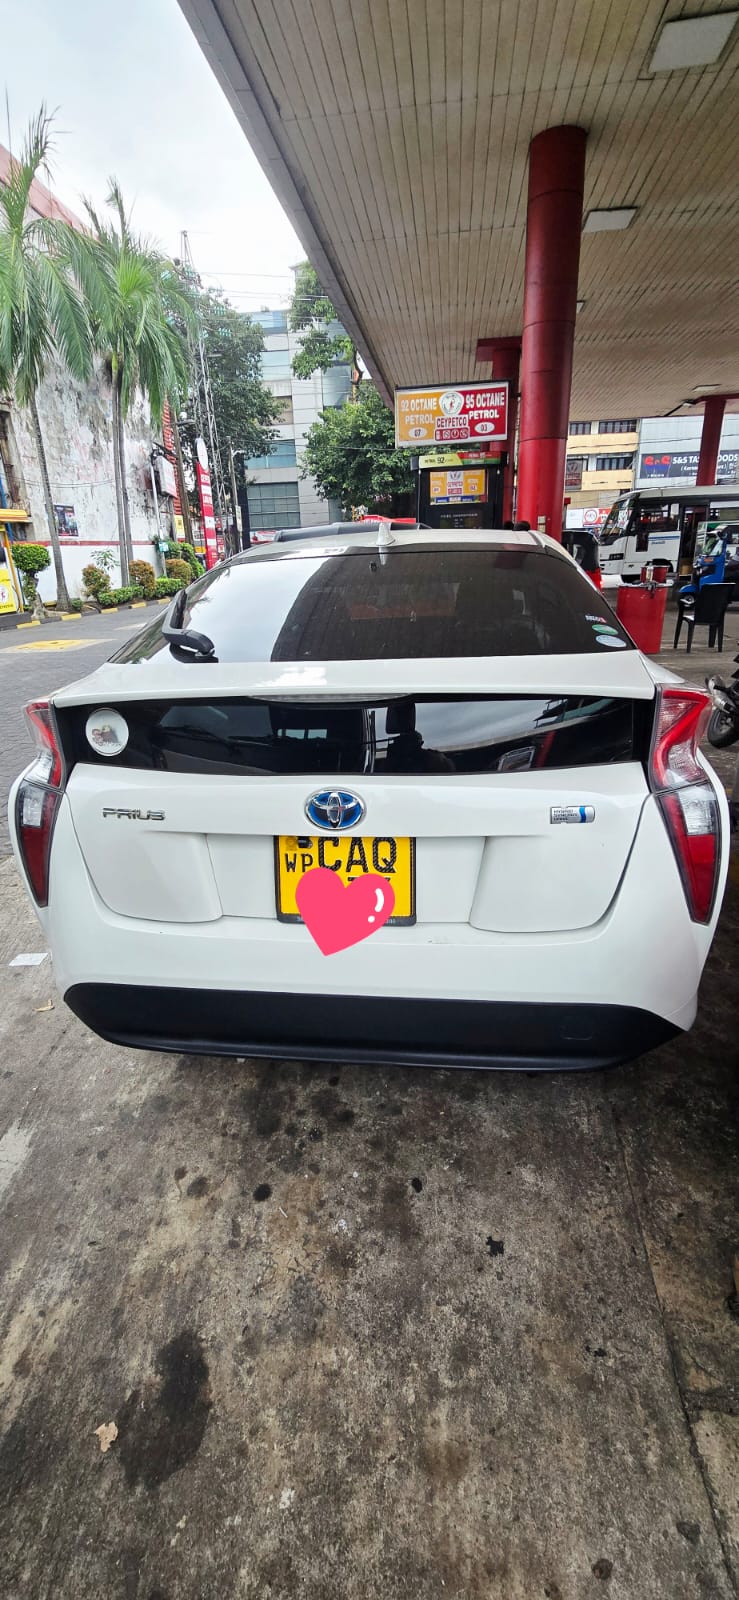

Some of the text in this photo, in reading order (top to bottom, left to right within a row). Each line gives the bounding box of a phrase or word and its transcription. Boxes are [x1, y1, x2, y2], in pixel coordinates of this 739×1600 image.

[400, 397, 437, 412] 92 OCTANE
[465, 391, 505, 409] 95 OCTANE
[405, 413, 434, 425] PETROL
[468, 409, 500, 420] PETROL
[436, 416, 467, 428] CEYPETCO
[672, 456, 688, 464] S&S
[718, 454, 739, 462] OODS
[102, 807, 166, 821] PRIUS
[285, 836, 397, 874] WP CAQ
